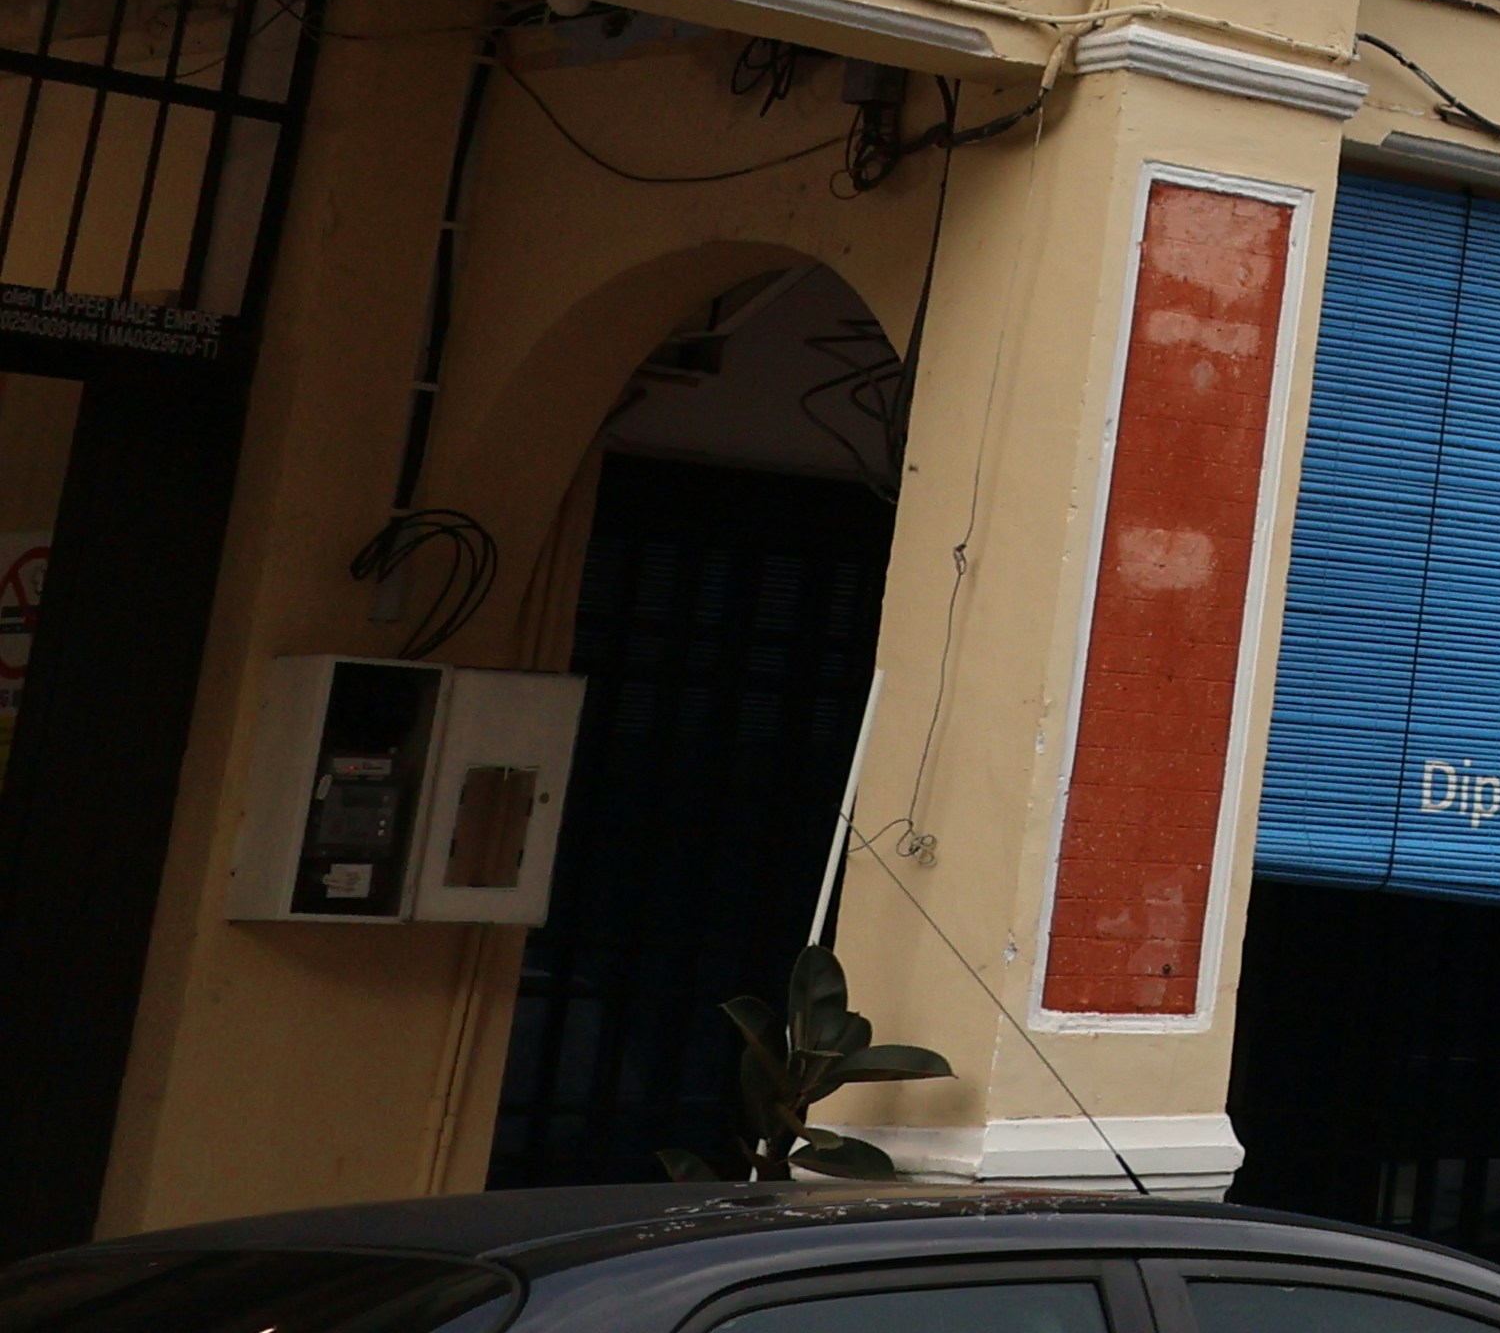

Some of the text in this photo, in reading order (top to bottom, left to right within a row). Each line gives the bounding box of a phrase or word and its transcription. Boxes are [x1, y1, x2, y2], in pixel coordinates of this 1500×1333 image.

[42, 289, 107, 318] DAPPER
[110, 300, 158, 326] MADE
[164, 307, 223, 334] EMPIRE
